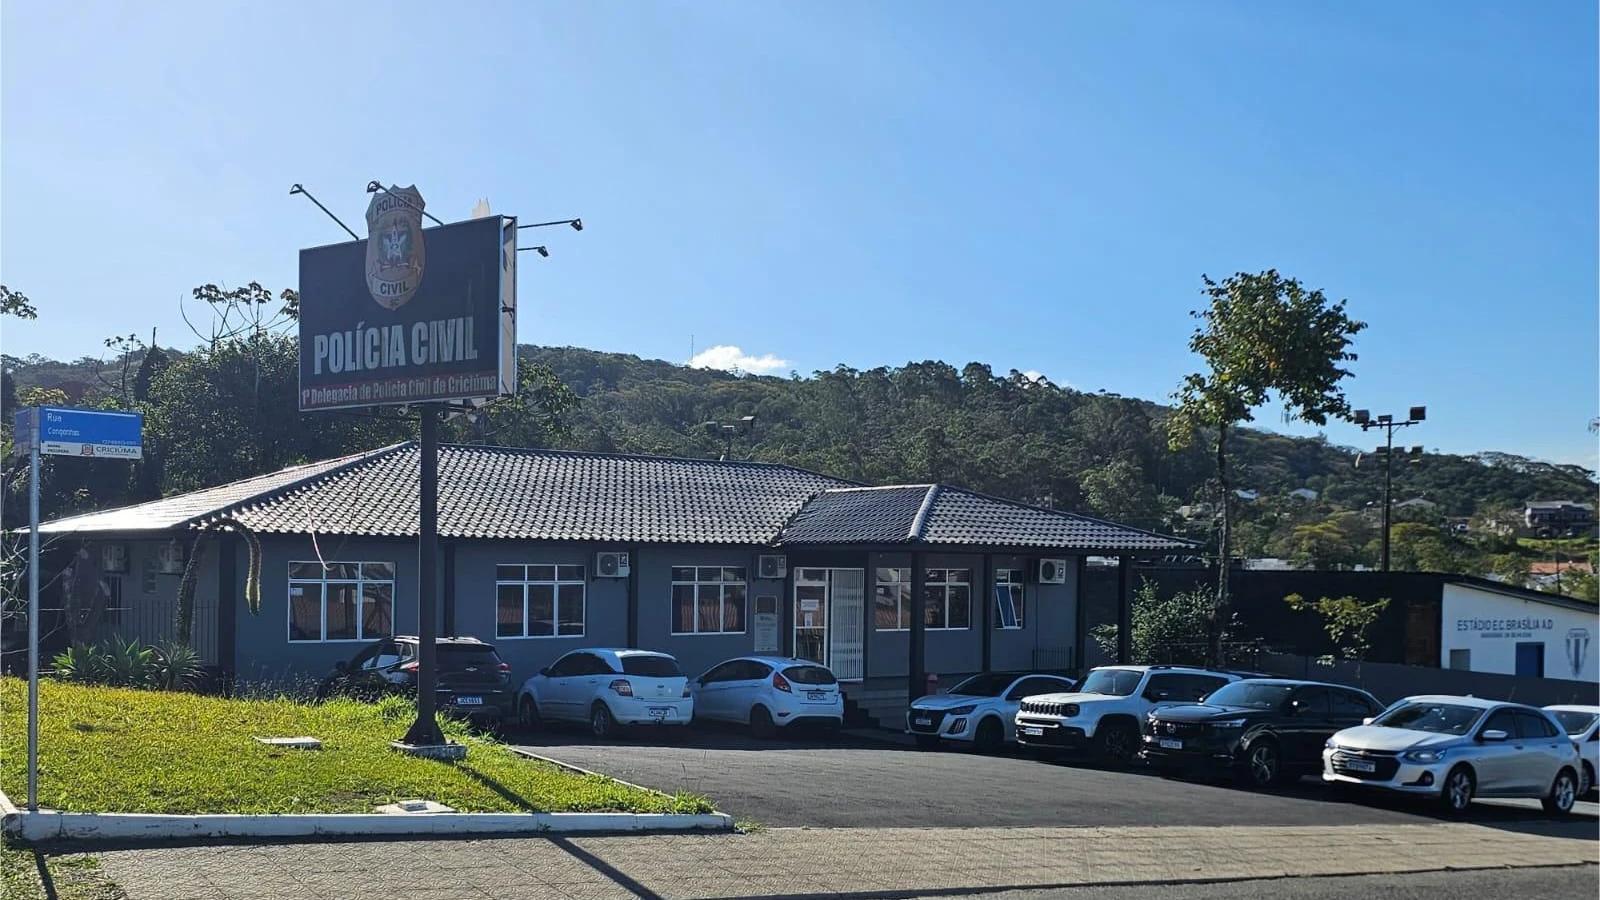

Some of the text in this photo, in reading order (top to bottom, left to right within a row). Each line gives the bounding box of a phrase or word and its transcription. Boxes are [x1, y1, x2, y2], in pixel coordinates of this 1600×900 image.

[379, 281, 409, 294] CIVIL
[314, 316, 478, 375] POLÍCIA CIVIL
[311, 386, 357, 405] Delegacia
[359, 384, 371, 400] de
[408, 379, 431, 397] Civil
[432, 379, 446, 394] de
[447, 375, 497, 393] Criciúma
[47, 413, 62, 422] Rua
[95, 446, 137, 454] CRICIÚMA
[1457, 617, 1491, 631] ESTÁDIO
[1506, 617, 1539, 630] BRASÍLIA
